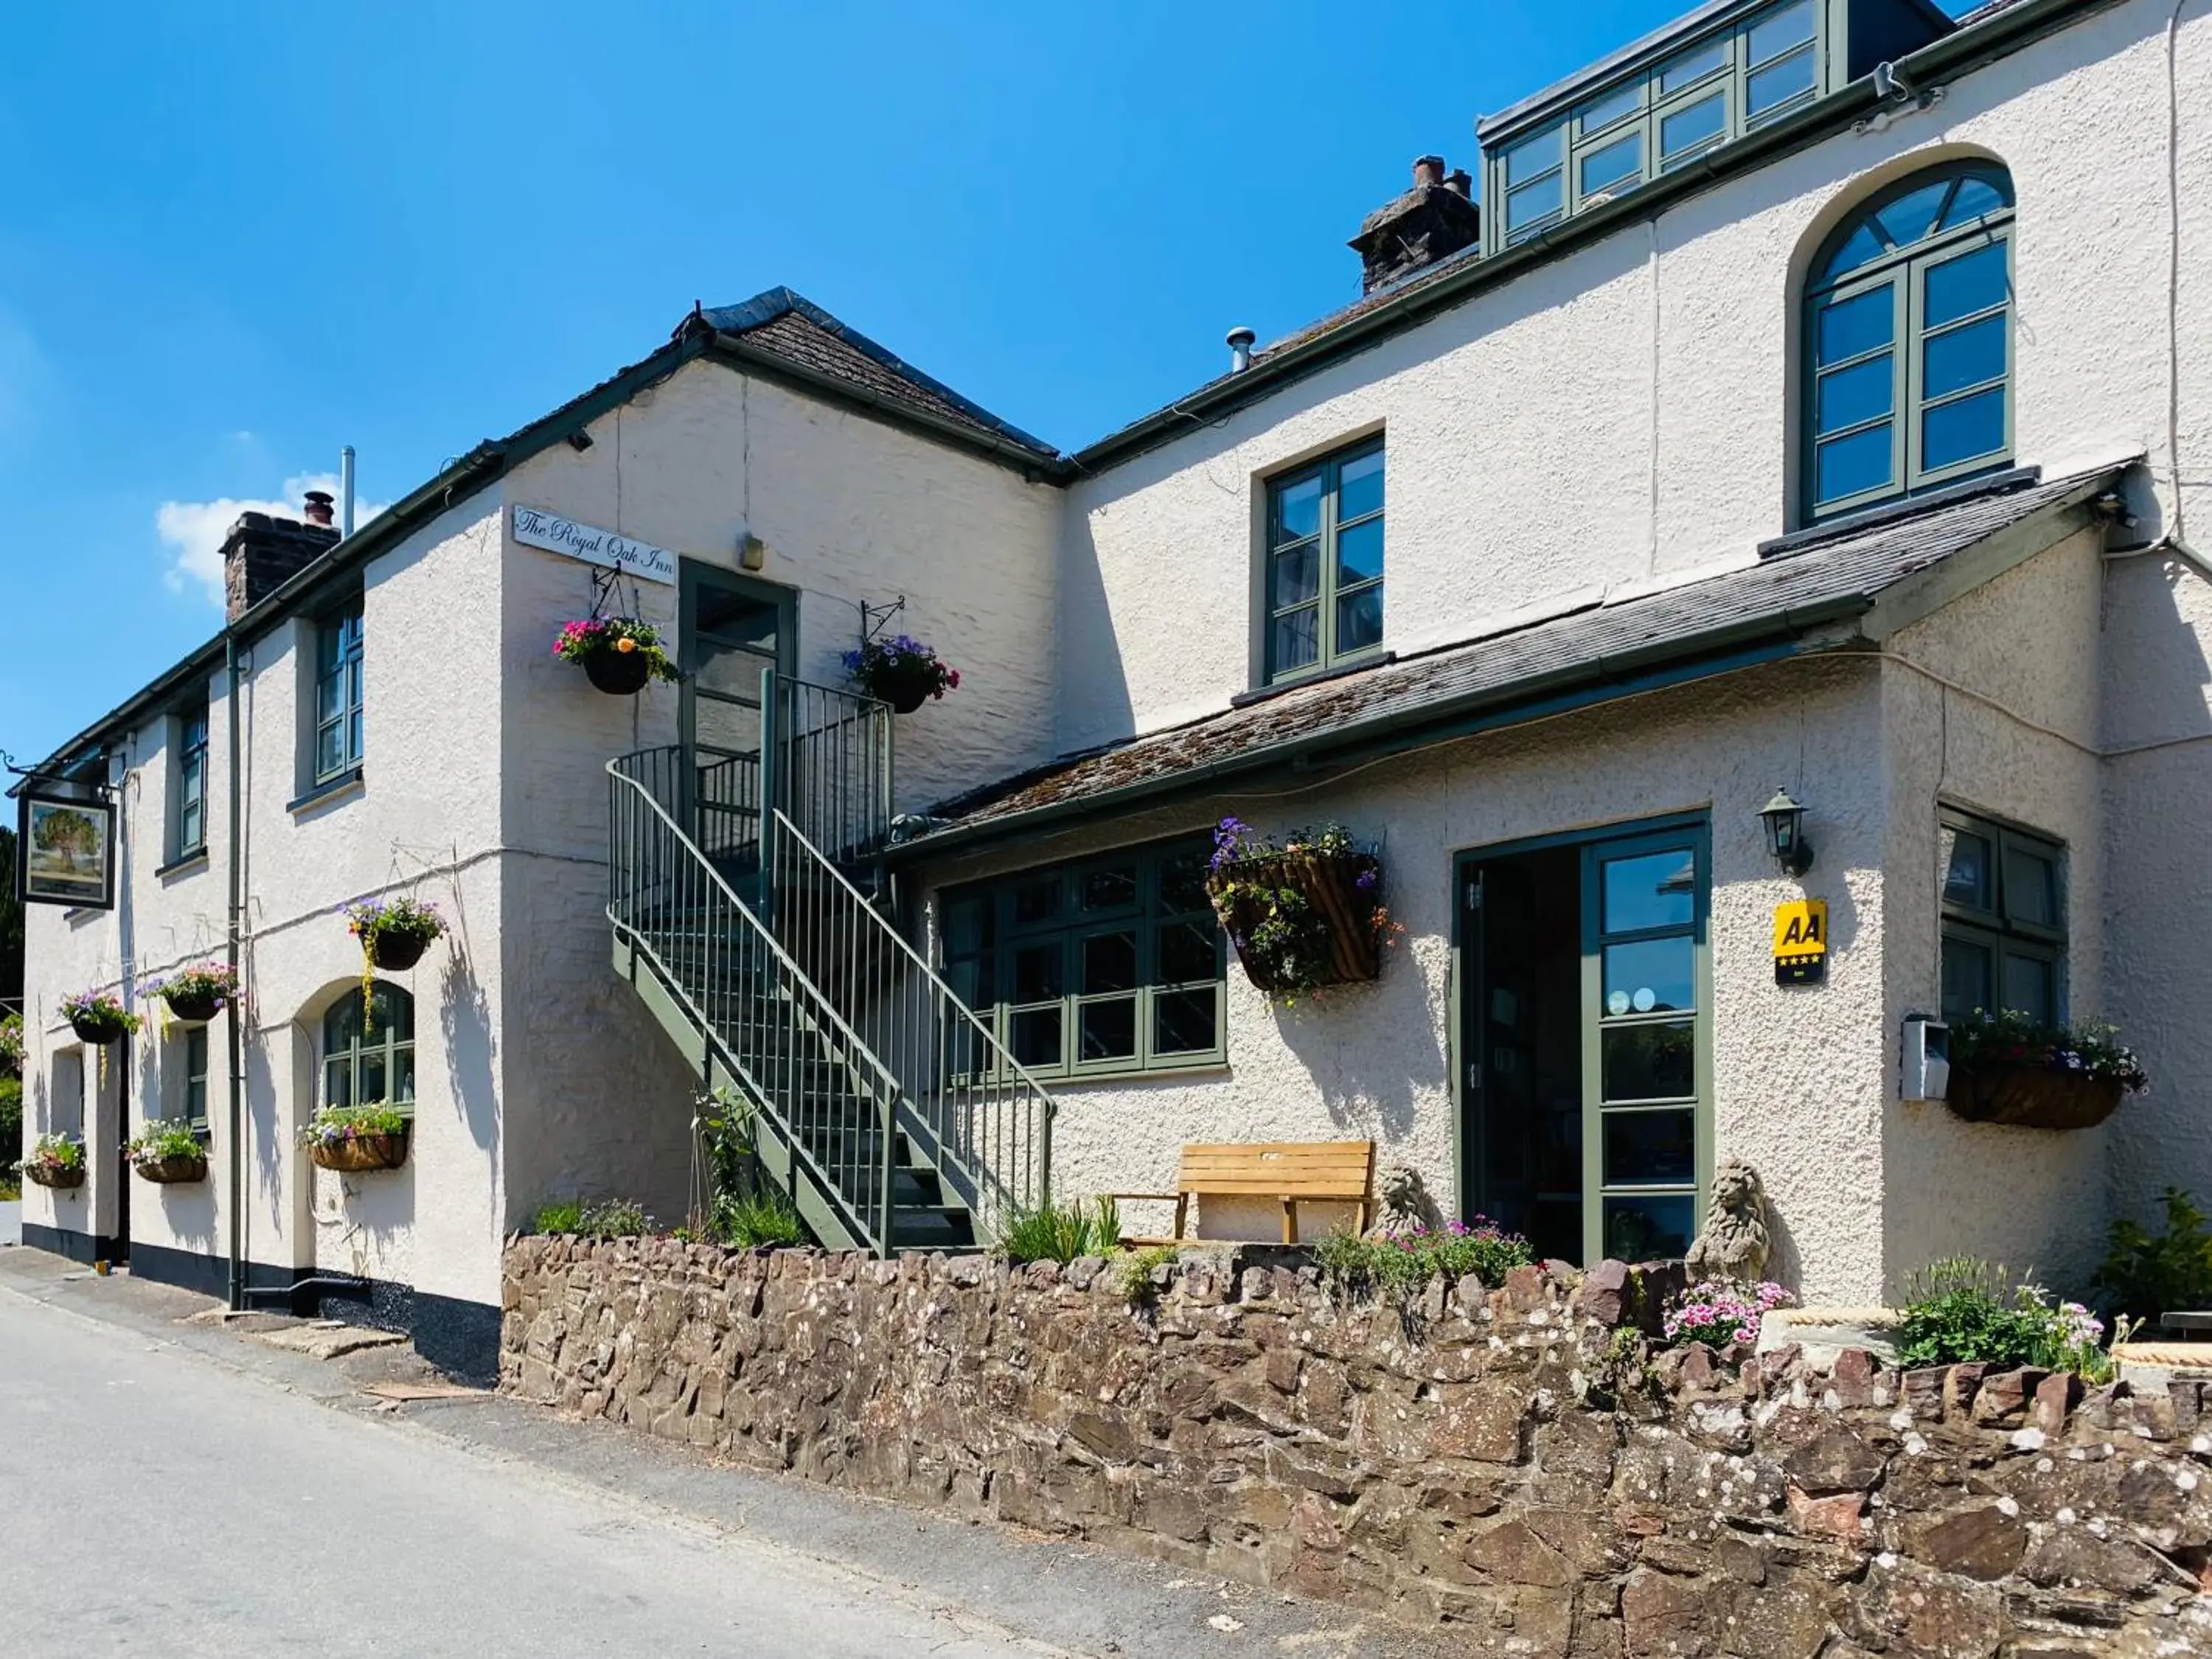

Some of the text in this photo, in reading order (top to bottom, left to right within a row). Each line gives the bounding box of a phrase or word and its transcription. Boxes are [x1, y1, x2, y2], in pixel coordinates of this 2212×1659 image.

[516, 510, 673, 574] The Royal Oak Inn
[1781, 914, 1820, 946] AA
